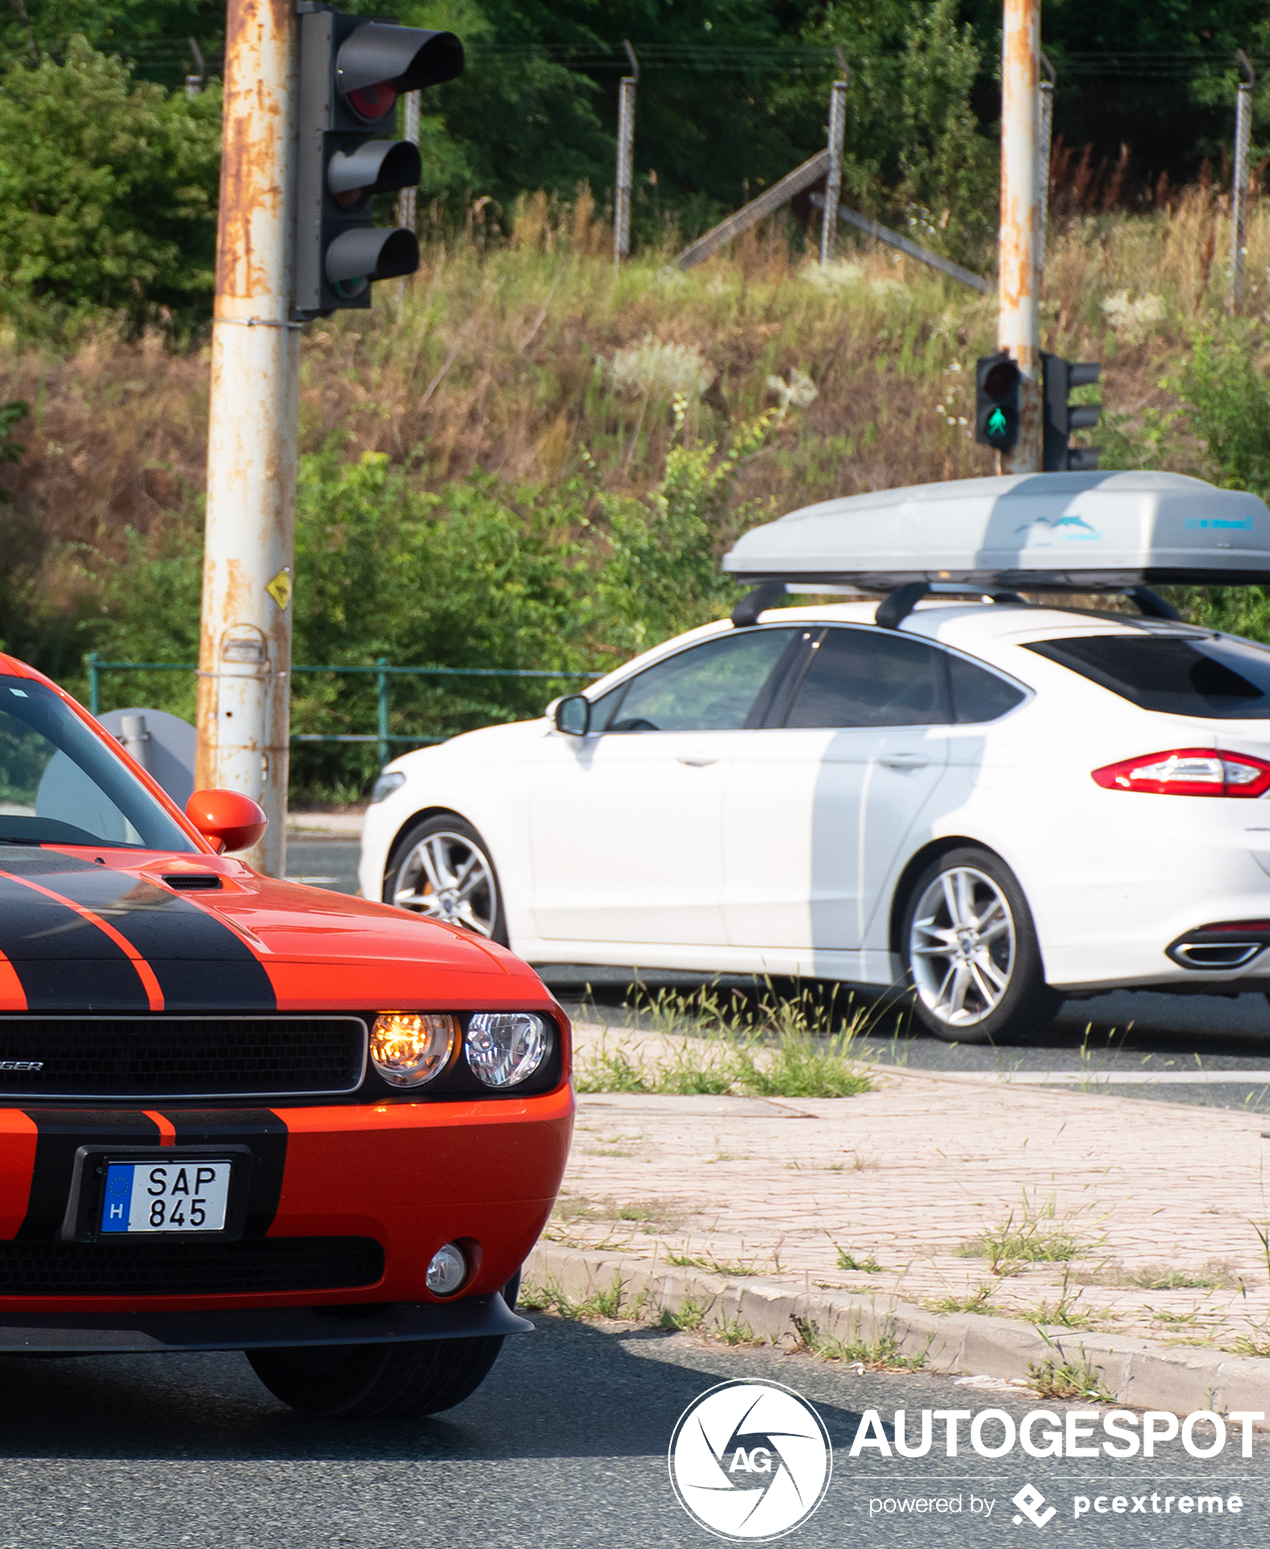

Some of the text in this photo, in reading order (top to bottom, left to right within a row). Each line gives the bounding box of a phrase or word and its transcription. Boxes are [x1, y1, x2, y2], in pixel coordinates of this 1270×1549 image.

[147, 1167, 216, 1196] SAP
[109, 1203, 123, 1219] H
[148, 1199, 207, 1227] 845
